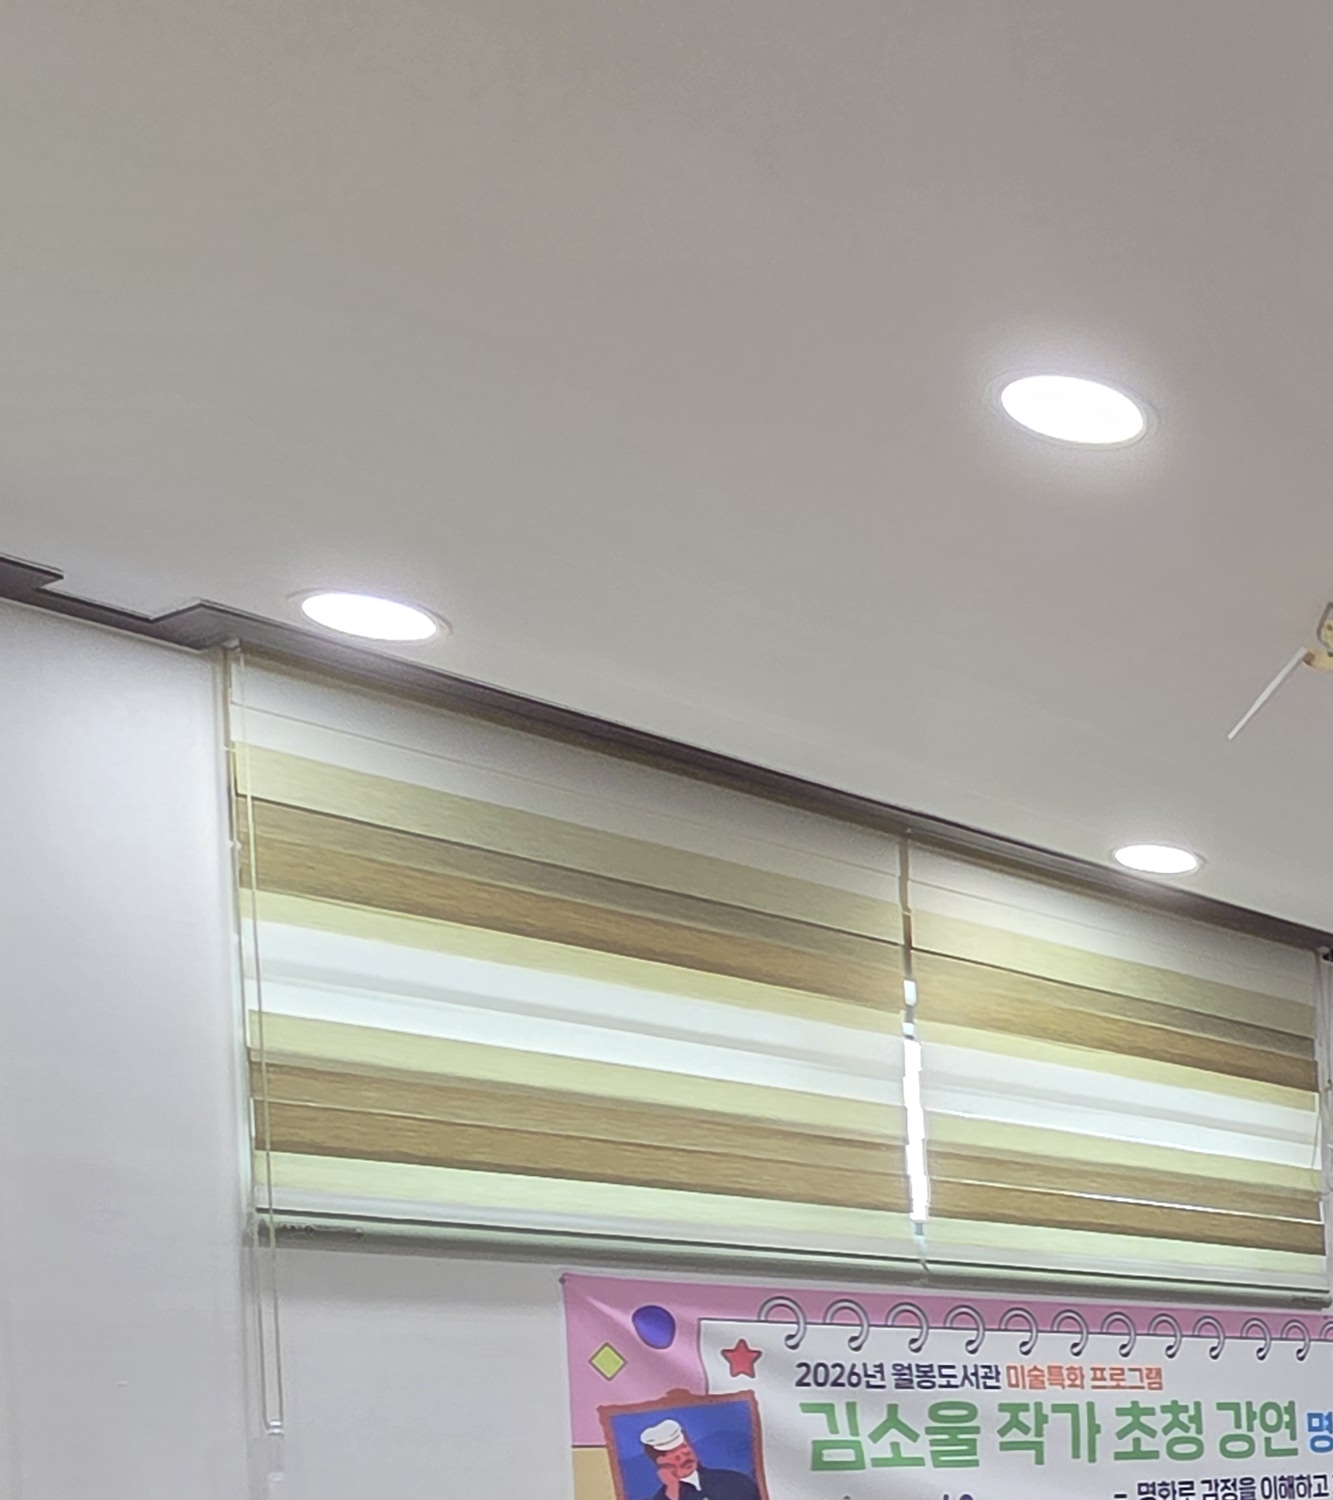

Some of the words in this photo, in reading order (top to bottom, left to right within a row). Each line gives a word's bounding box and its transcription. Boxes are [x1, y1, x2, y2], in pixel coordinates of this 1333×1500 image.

[795, 1362, 887, 1390] 2026년
[891, 1362, 1002, 1390] 월봉도서관
[1006, 1365, 1085, 1390] 미술특화
[1090, 1365, 1163, 1391] 프로그램
[799, 1400, 981, 1471] 김소울
[996, 1401, 1101, 1466] 작가
[1113, 1400, 1205, 1461] 초청
[1216, 1400, 1299, 1459] 강연
[1260, 1474, 1330, 1500] 이해하고
